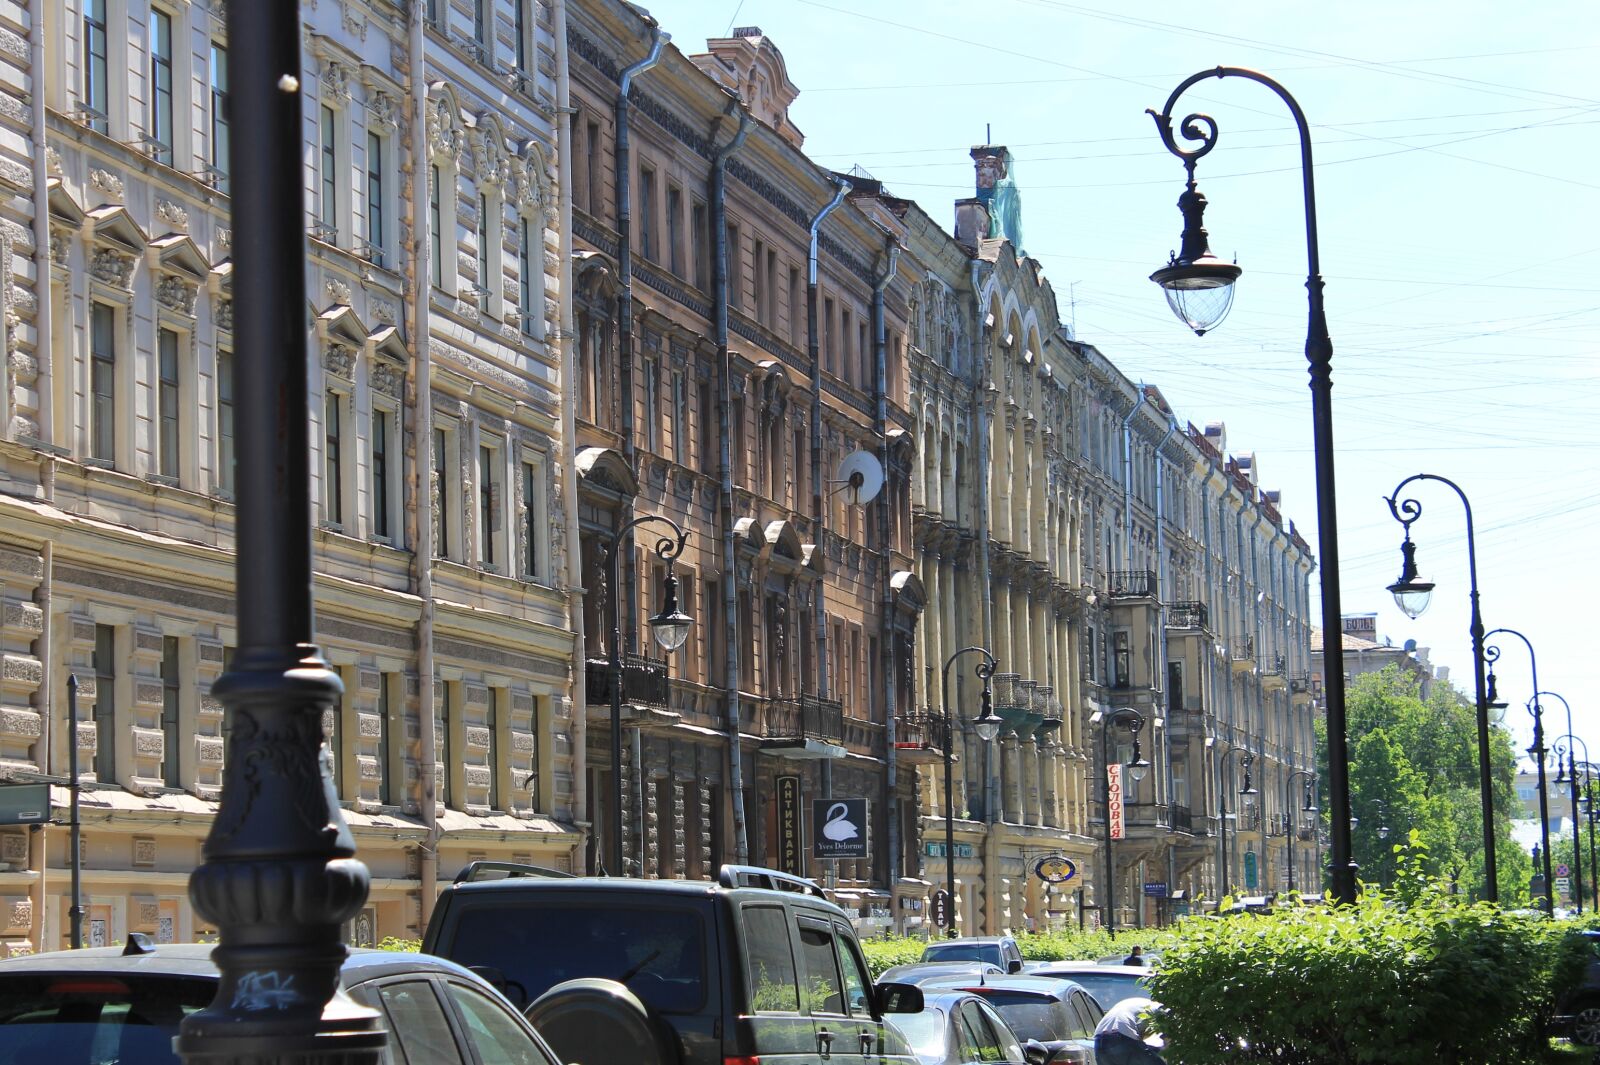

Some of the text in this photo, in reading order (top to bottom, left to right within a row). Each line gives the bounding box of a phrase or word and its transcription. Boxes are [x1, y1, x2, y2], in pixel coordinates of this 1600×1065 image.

[1109, 765, 1121, 838] СТОЛОВАЯ
[818, 842, 863, 850] Yves Delorme
